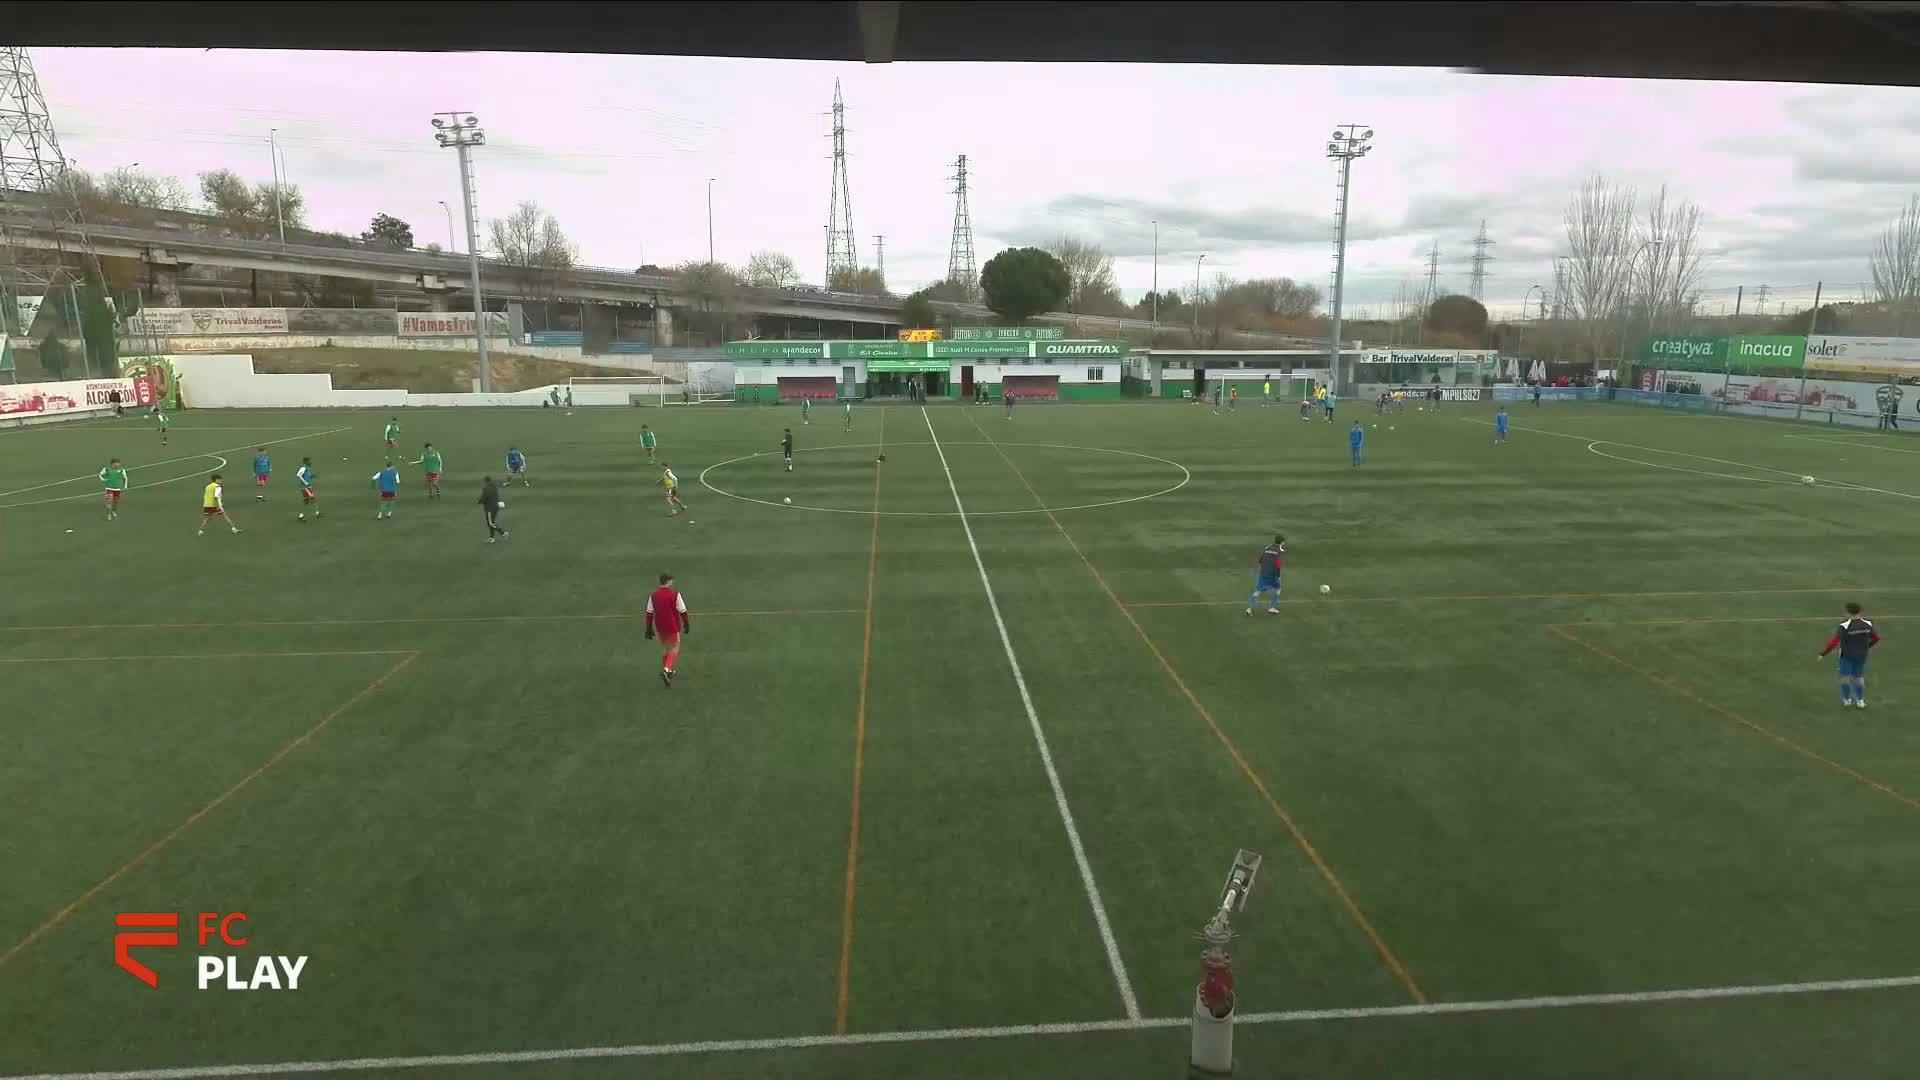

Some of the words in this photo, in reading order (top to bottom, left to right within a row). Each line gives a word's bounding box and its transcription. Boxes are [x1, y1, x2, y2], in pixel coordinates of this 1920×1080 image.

[1046, 345, 1120, 354] QUAMTRAX
[1740, 340, 1793, 357] inacua
[1372, 354, 1388, 362] Bar
[86, 385, 137, 405] ALCOCÓN
